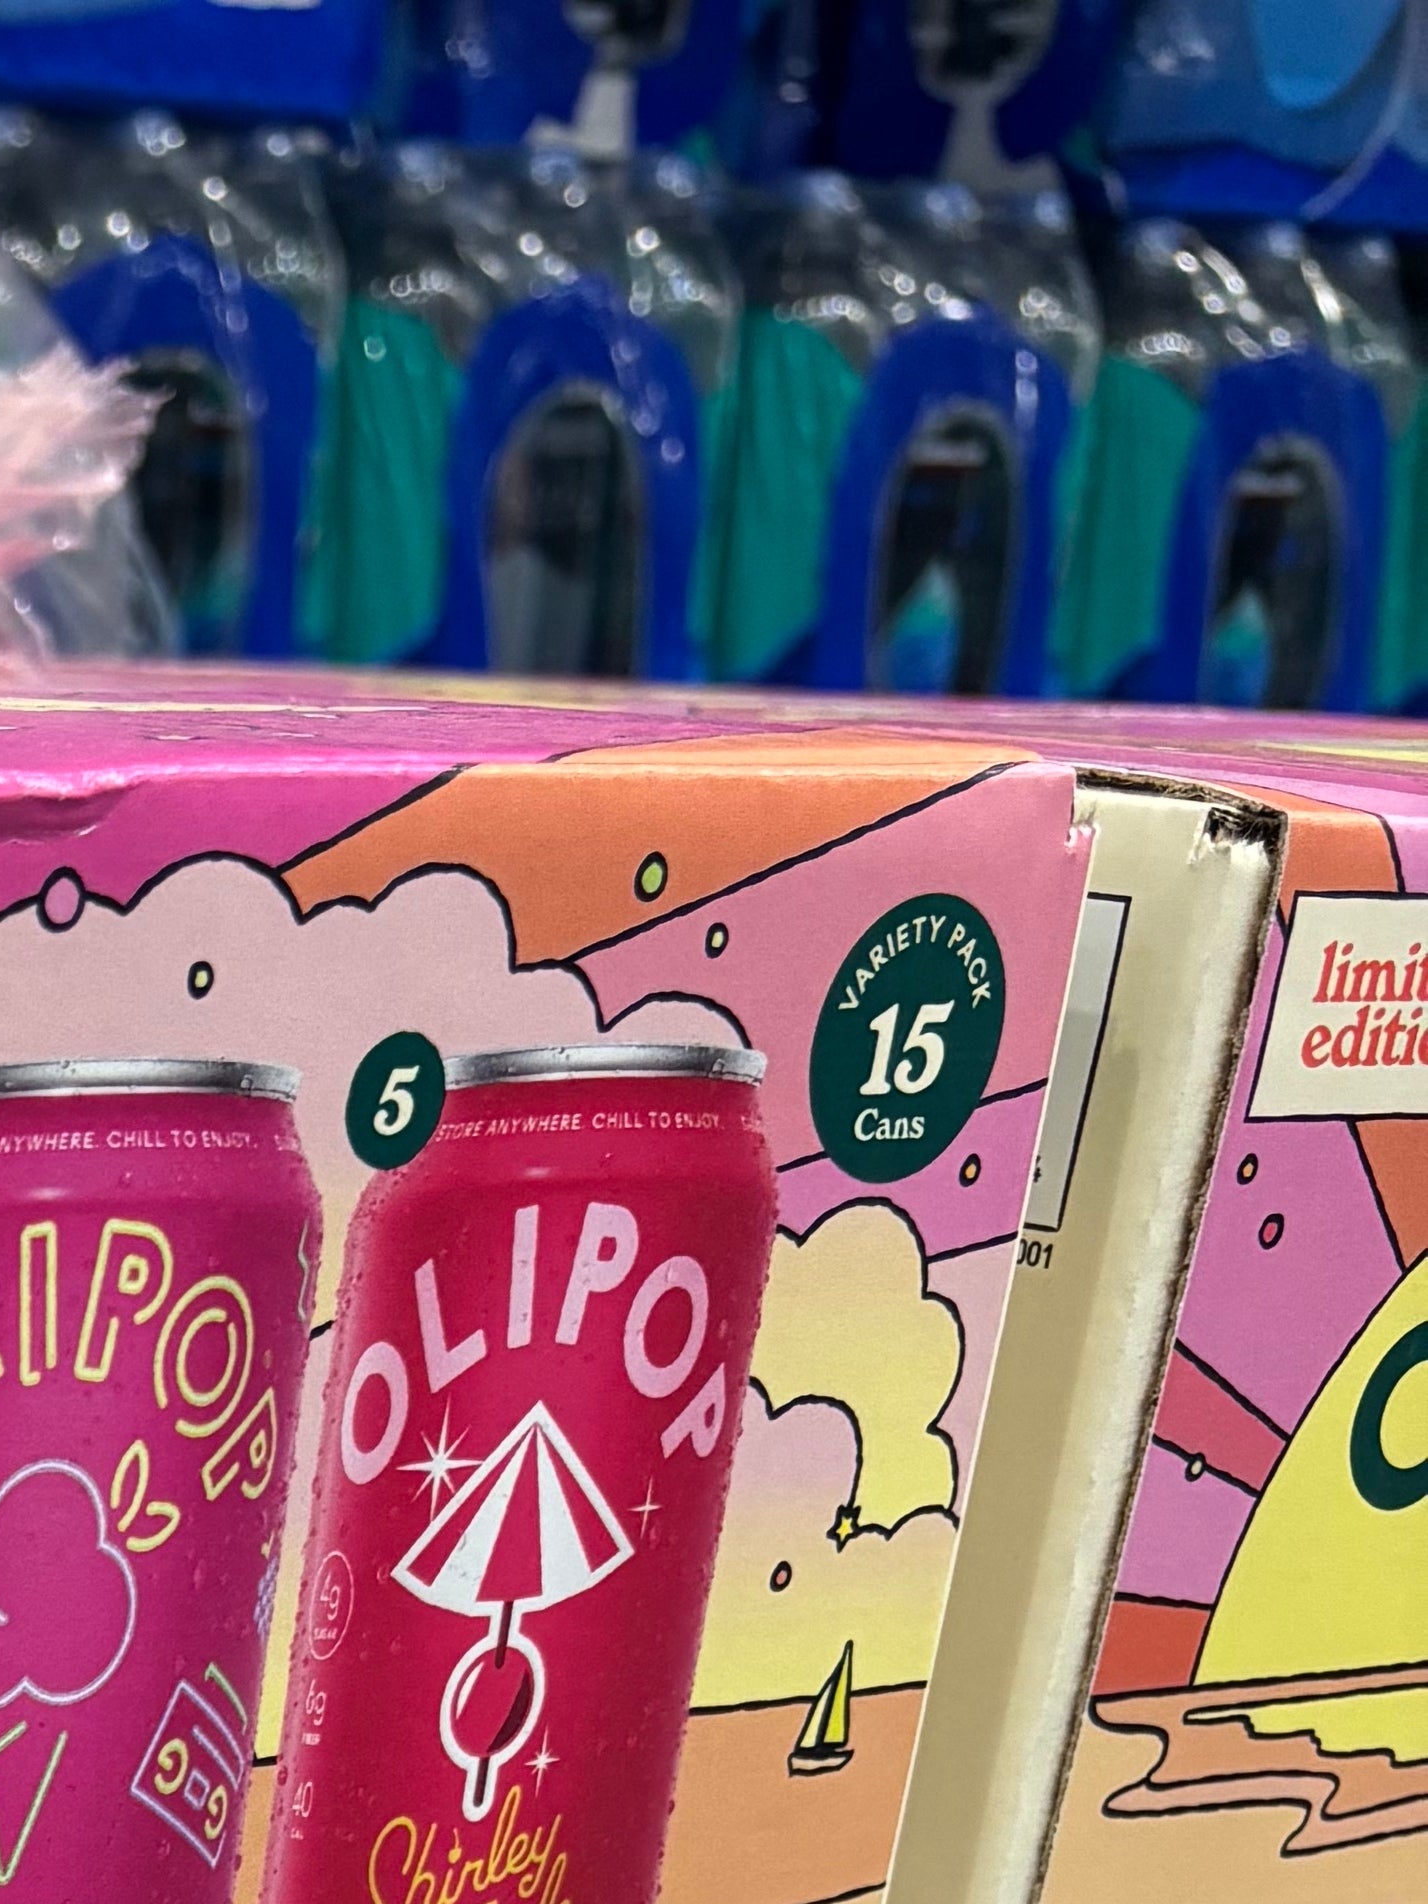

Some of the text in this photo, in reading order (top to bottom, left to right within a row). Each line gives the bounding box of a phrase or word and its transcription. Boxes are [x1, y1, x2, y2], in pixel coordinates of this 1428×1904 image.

[838, 915, 991, 1010] VARIETY PACK
[859, 1000, 955, 1095] 15
[373, 1065, 419, 1136] 5
[854, 1108, 925, 1141] Cans
[341, 1201, 726, 1485] OLIPOP
